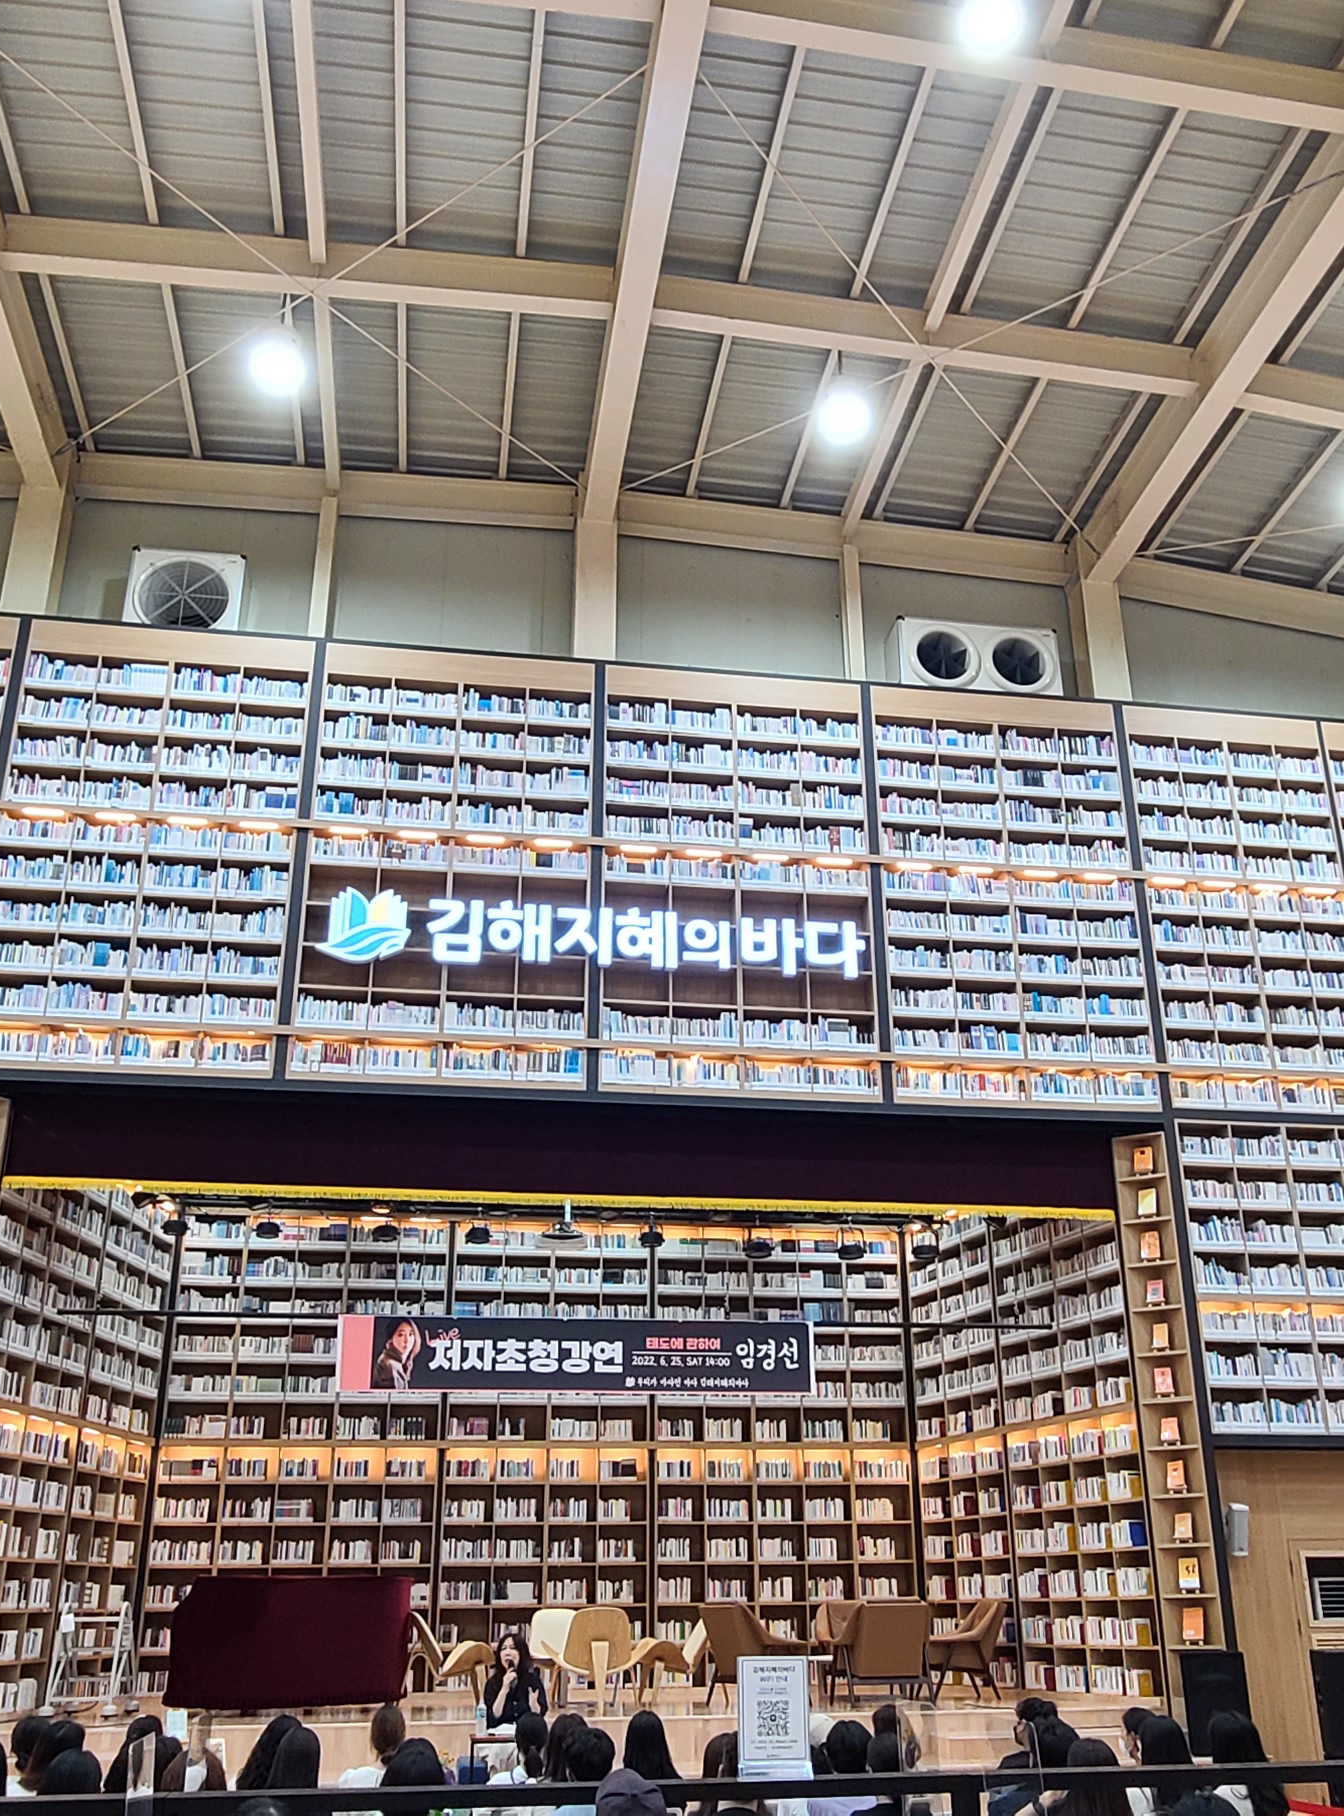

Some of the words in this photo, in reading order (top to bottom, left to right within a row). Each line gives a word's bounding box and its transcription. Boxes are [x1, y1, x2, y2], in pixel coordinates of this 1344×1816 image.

[426, 896, 866, 980] 김해지혜의바다
[428, 1338, 623, 1373] 저자초청강연
[686, 1357, 703, 1367] SAT
[705, 1357, 731, 1367] 14:00
[736, 1337, 799, 1371] 임경선
